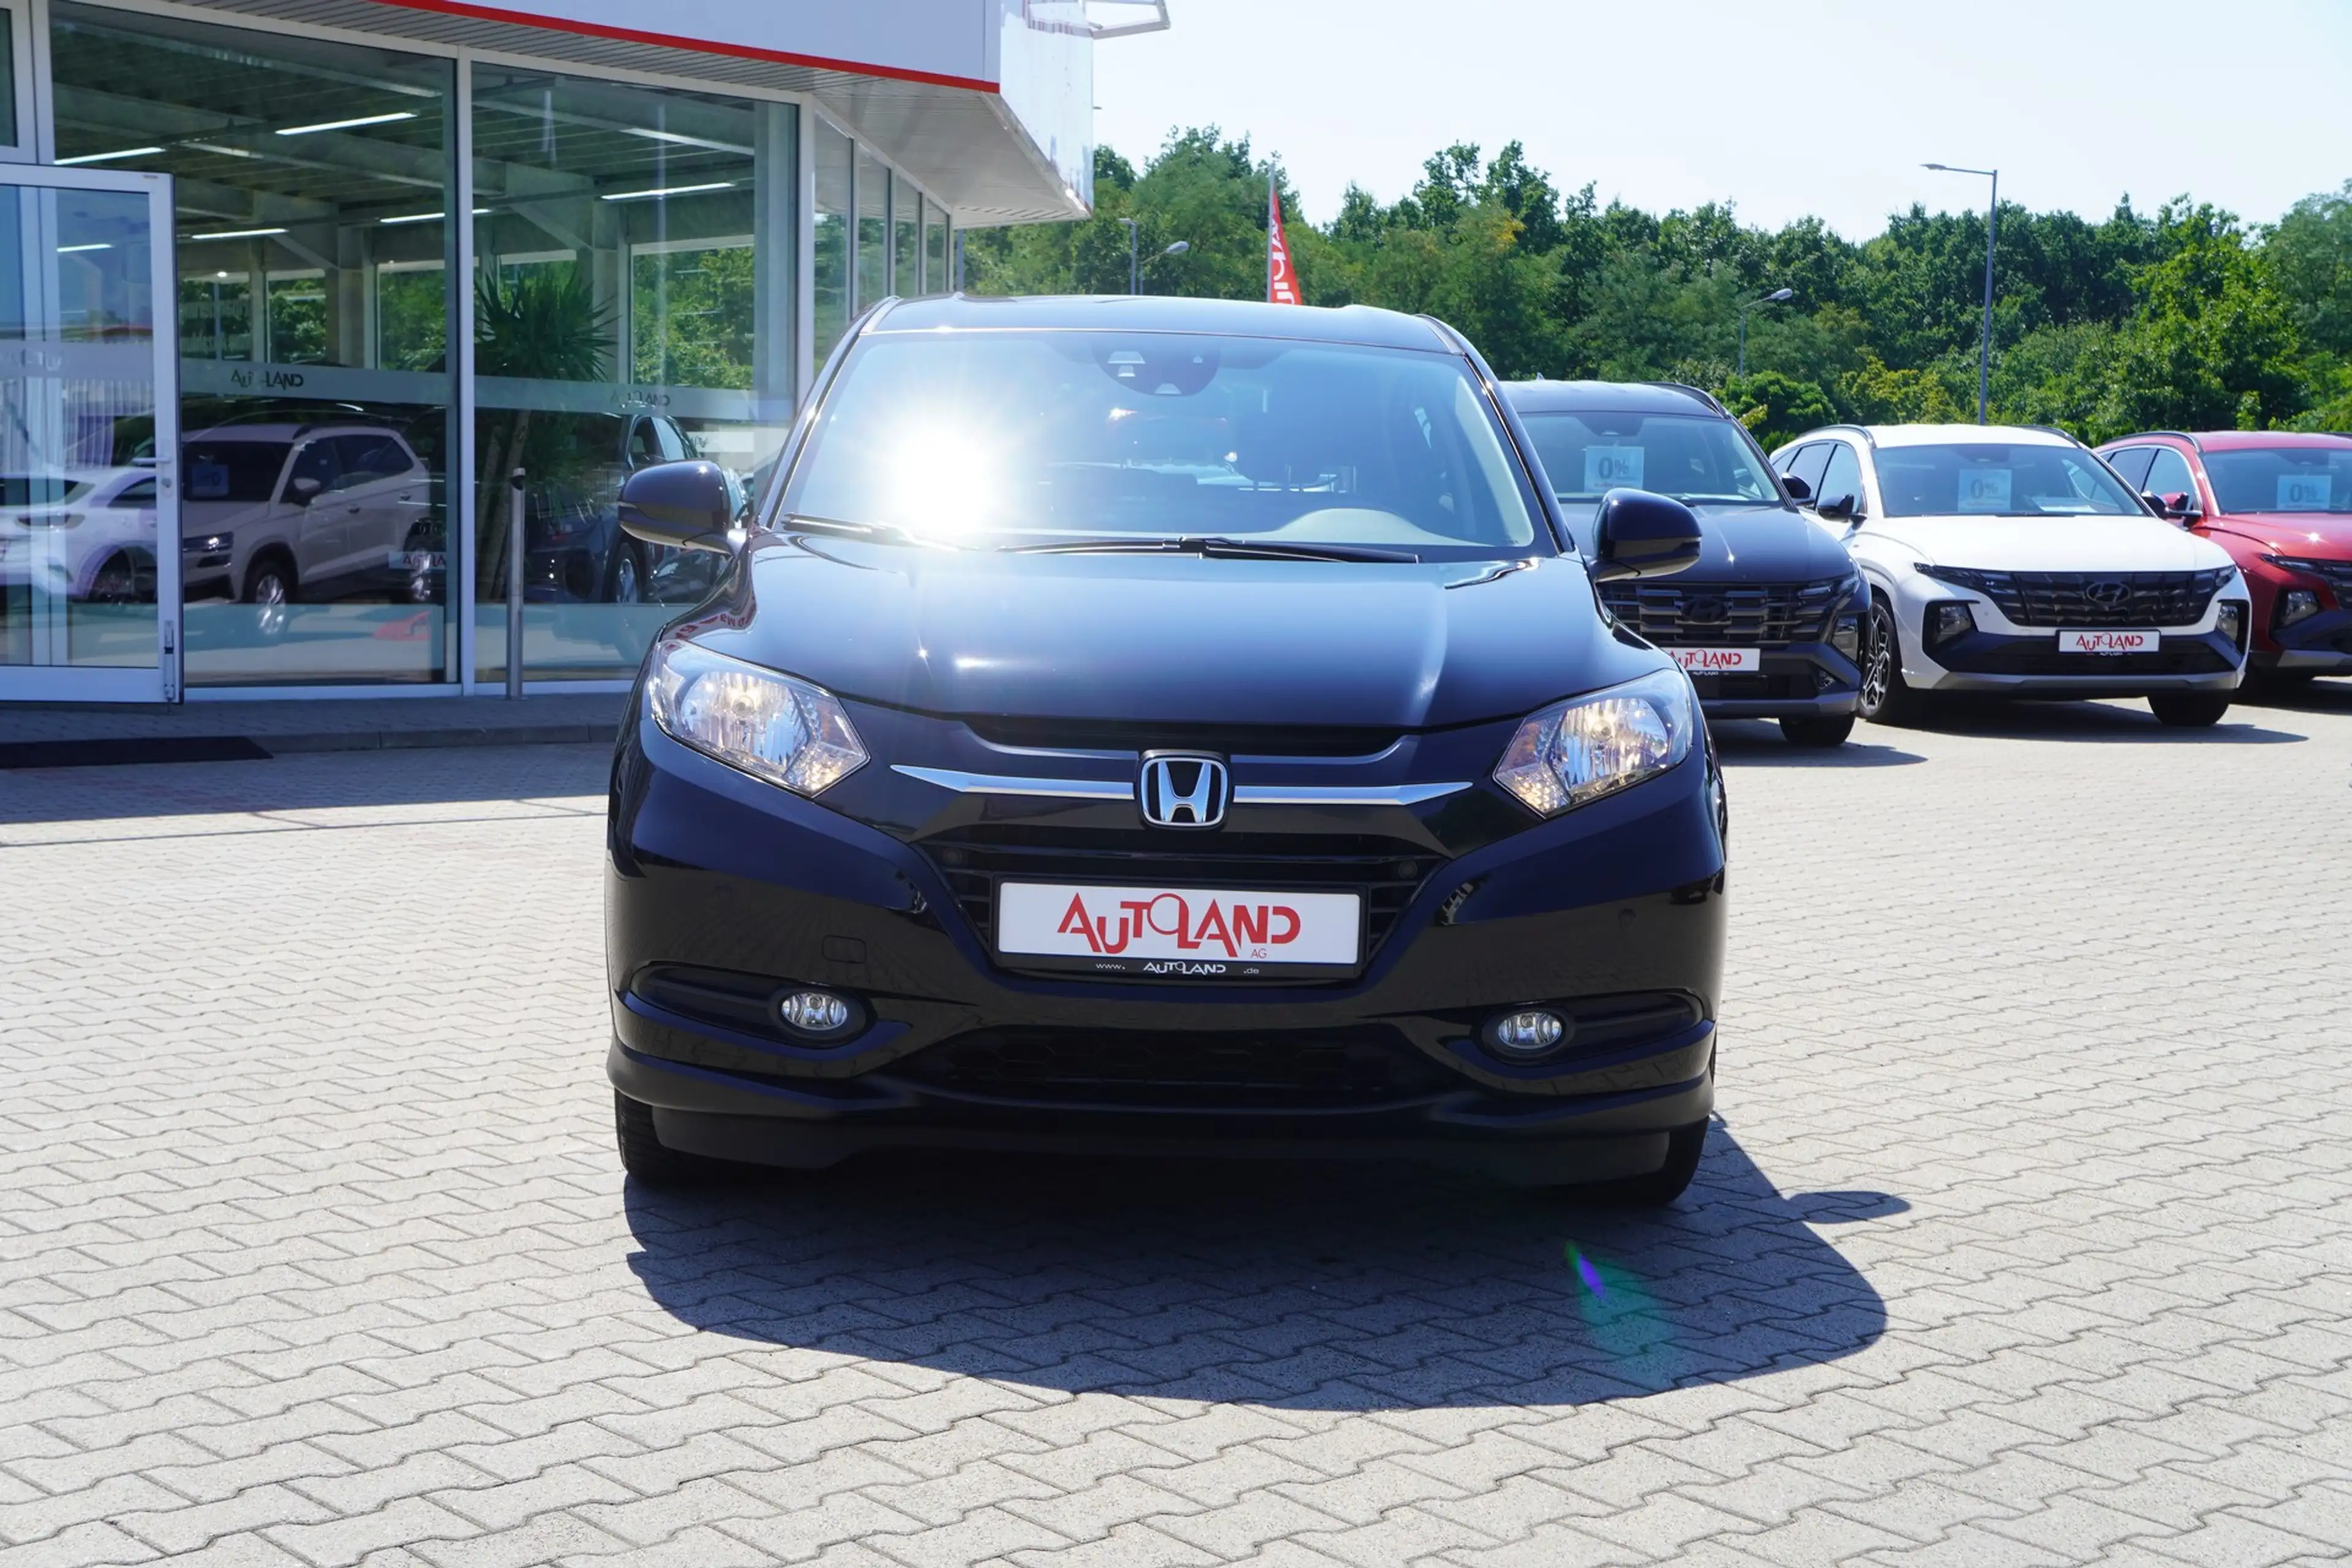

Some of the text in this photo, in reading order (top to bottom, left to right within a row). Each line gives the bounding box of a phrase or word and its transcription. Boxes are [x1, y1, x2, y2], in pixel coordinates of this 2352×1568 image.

[1598, 456, 1629, 480] 0%
[2076, 631, 2144, 651] AUTOLAND
[1057, 891, 1301, 958] AUTOLAND
[1250, 948, 1267, 959] AG
[1143, 961, 1227, 976] AUTOLAND
